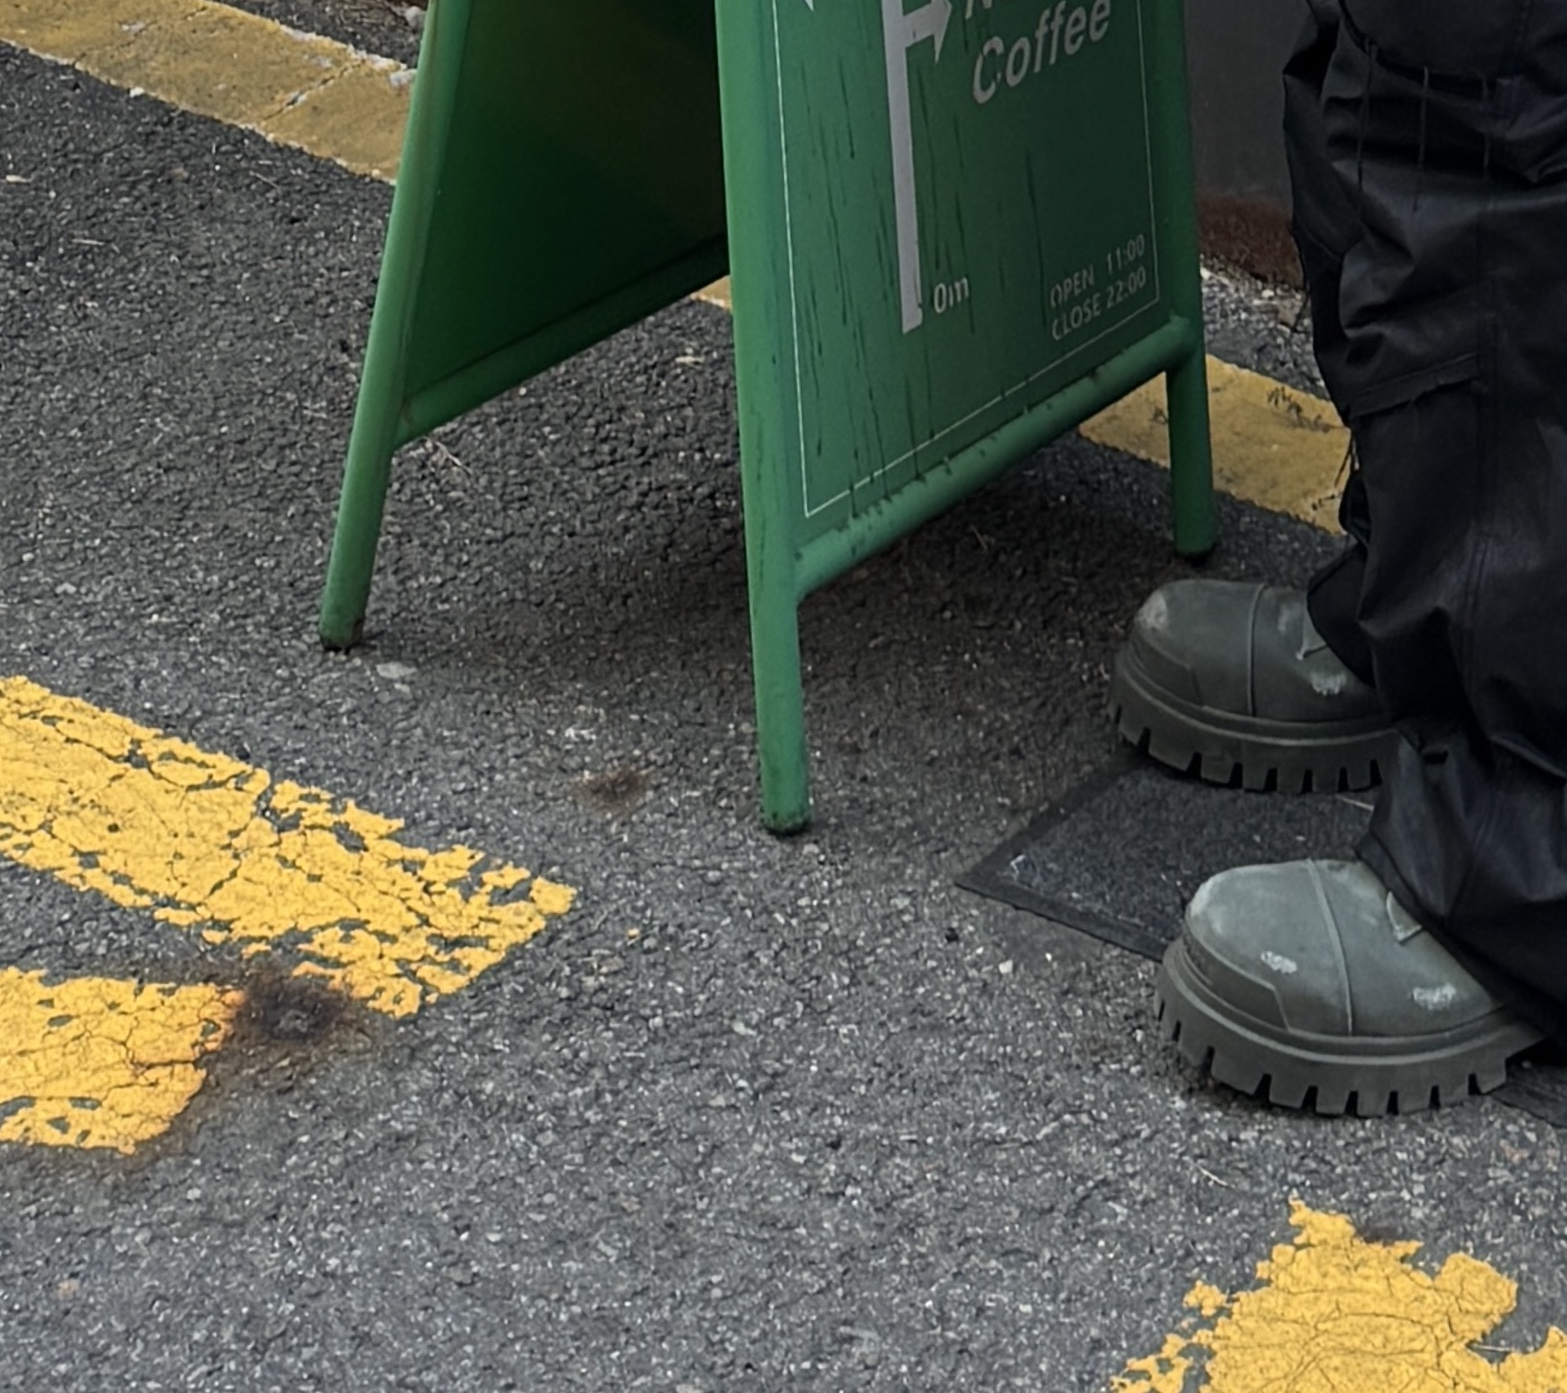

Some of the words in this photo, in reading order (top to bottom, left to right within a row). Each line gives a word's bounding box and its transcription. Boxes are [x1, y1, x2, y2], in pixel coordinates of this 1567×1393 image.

[1050, 263, 1096, 308] OPEN
[1106, 233, 1146, 275] 11:00
[1051, 292, 1102, 342] CLOSE
[1106, 265, 1147, 309] 22:00
